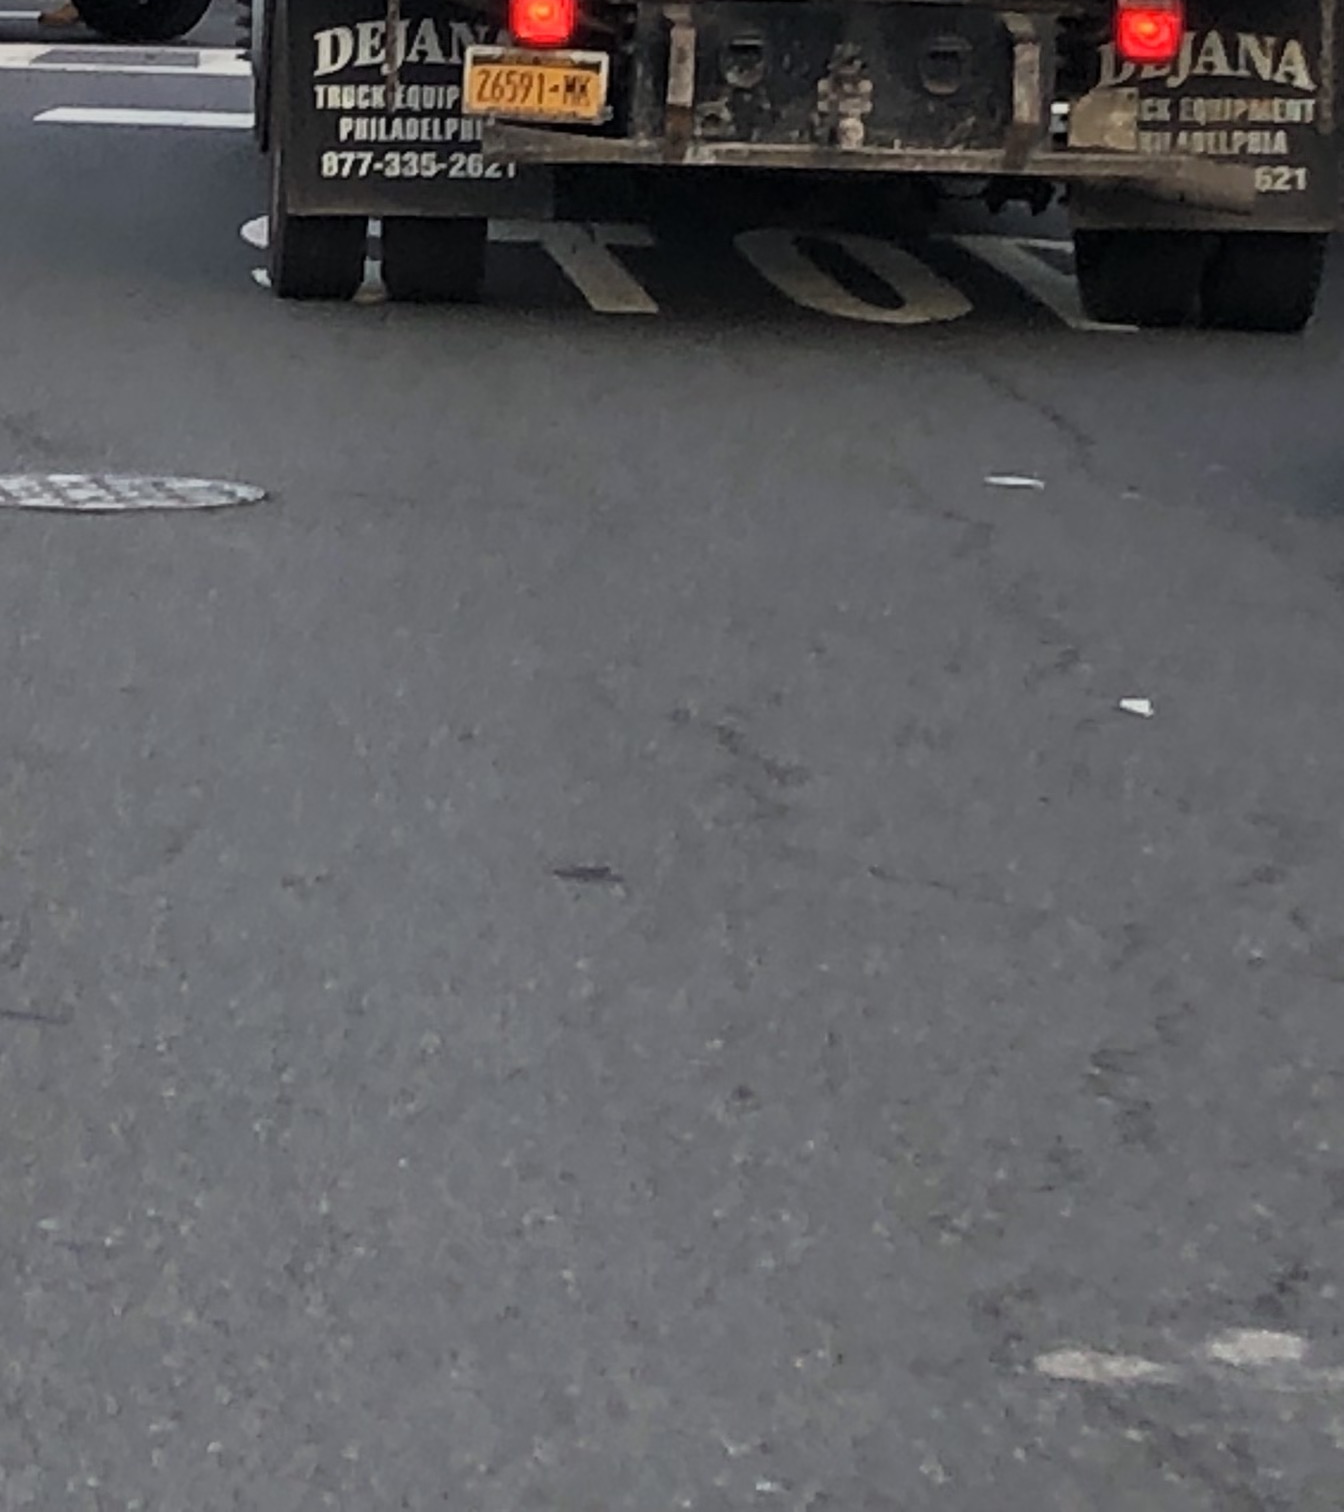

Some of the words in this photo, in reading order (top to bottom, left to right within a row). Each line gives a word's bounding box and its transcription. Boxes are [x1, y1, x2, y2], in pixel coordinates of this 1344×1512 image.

[1097, 30, 1317, 91] DJANA
[314, 84, 386, 110] TRUCK
[394, 84, 460, 111] EQUIP
[338, 117, 482, 142] PHILADELPHI
